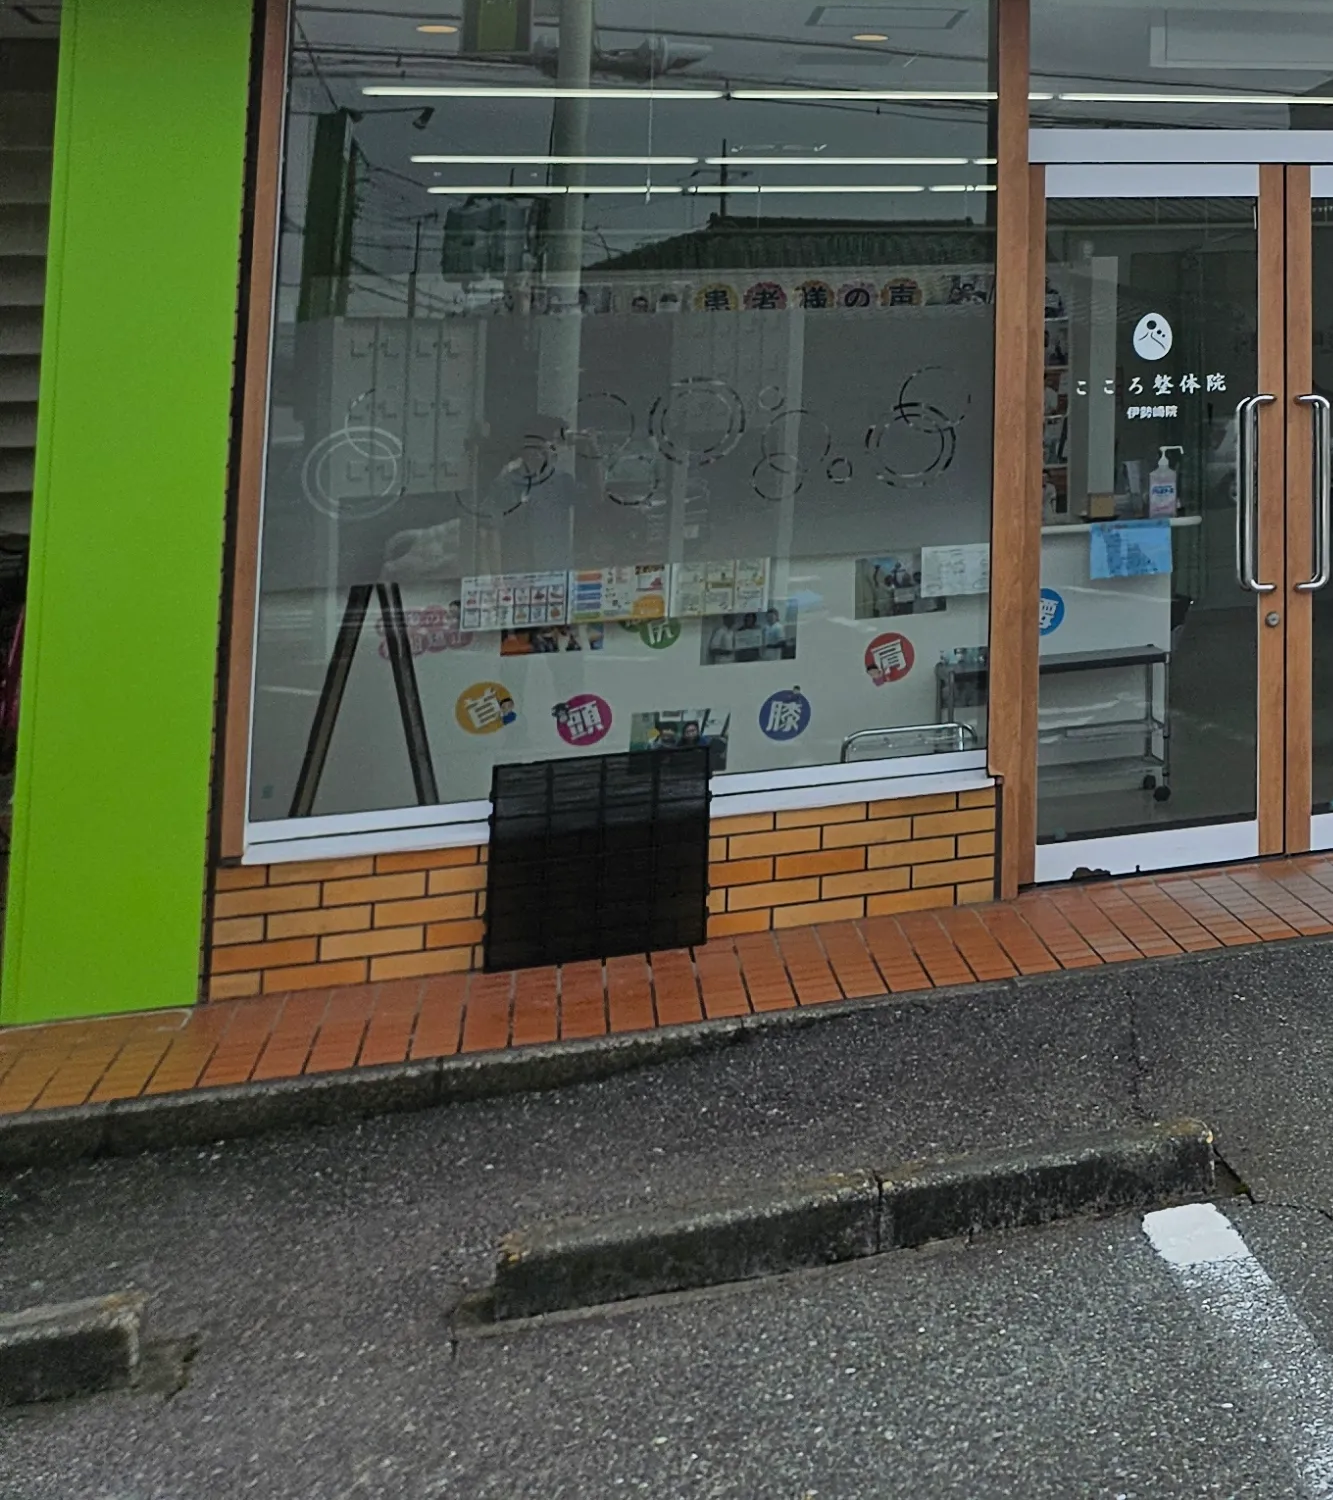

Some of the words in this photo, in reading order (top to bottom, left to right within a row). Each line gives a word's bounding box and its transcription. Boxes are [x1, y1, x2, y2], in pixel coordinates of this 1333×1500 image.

[1076, 373, 1227, 395] こころ整体院
[464, 687, 502, 729] 首
[566, 700, 604, 741] 頭
[766, 700, 803, 733] 膝
